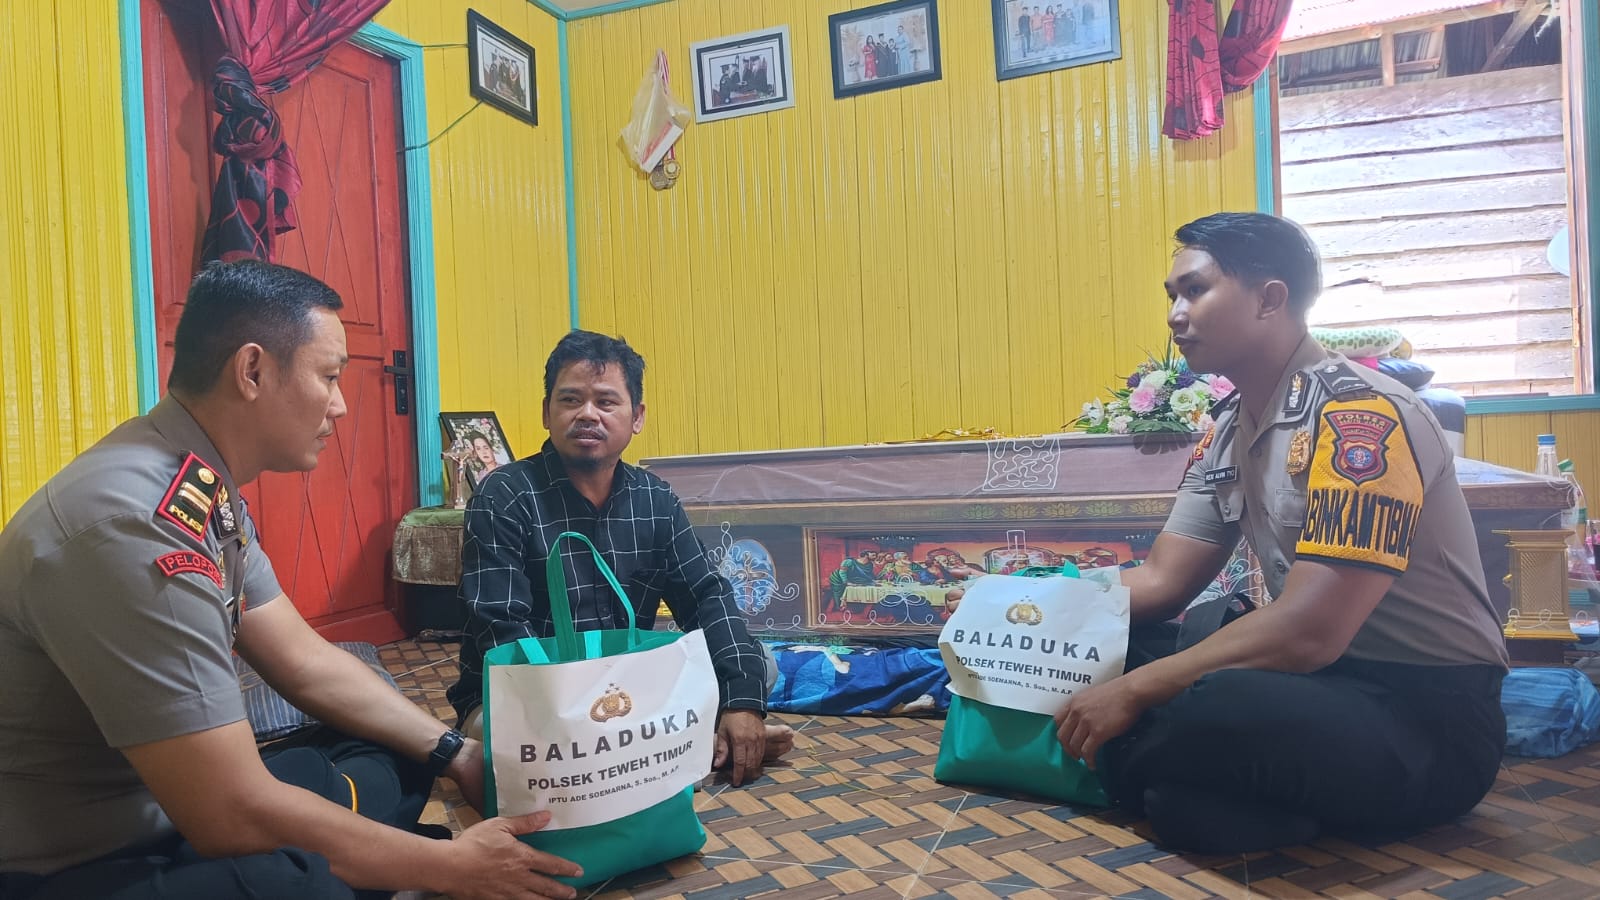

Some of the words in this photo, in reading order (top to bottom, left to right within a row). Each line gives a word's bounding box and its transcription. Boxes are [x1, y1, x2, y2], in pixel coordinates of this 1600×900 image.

[953, 629, 1100, 662] BALADUKA
[955, 655, 996, 669] POLSEK
[998, 660, 1043, 677] TEWEH
[1047, 668, 1092, 685] TIMUR
[520, 708, 699, 763] BALADUKA
[528, 772, 594, 790] POLSEK
[598, 753, 650, 781] TEWEH
[653, 740, 694, 764] TIMUR
[570, 794, 587, 802] ADE
[588, 782, 634, 800] SOEMARNA,
